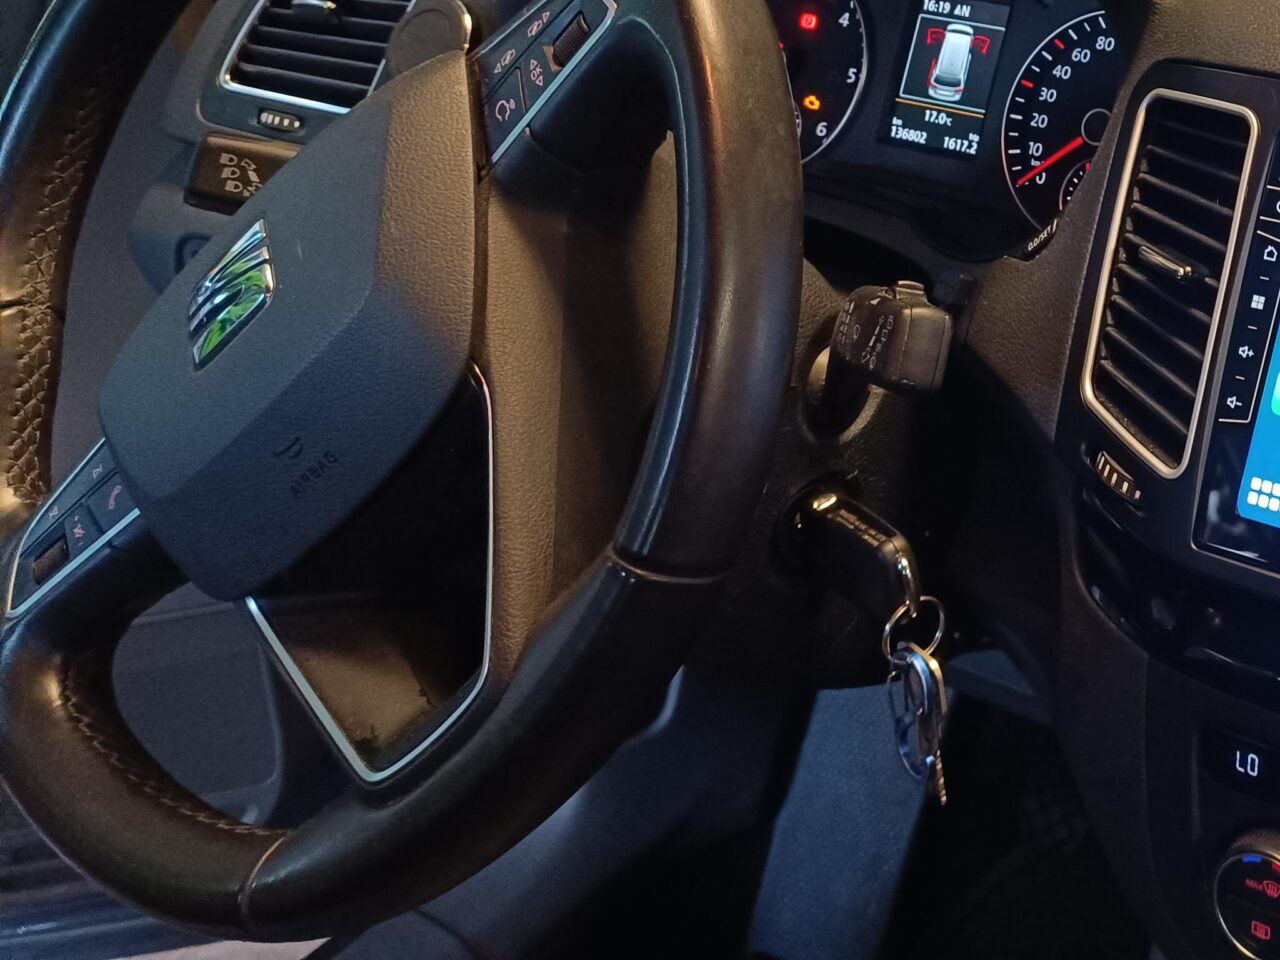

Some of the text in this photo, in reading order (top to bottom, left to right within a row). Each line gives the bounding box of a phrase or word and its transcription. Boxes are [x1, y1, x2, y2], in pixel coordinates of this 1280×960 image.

[953, 3, 971, 18] AN
[838, 12, 850, 27] 4
[1095, 36, 1115, 52] 80
[1071, 48, 1091, 63] 60
[530, 64, 543, 81] OK
[846, 68, 857, 83] 5
[1052, 65, 1071, 80] 40
[1039, 87, 1057, 103] 30
[1030, 113, 1048, 129] 20
[815, 122, 828, 137] 6
[890, 125, 978, 155] 136802 1617.2
[1028, 142, 1043, 157] 10
[1035, 172, 1046, 185] 0
[1236, 750, 1259, 777] LO
